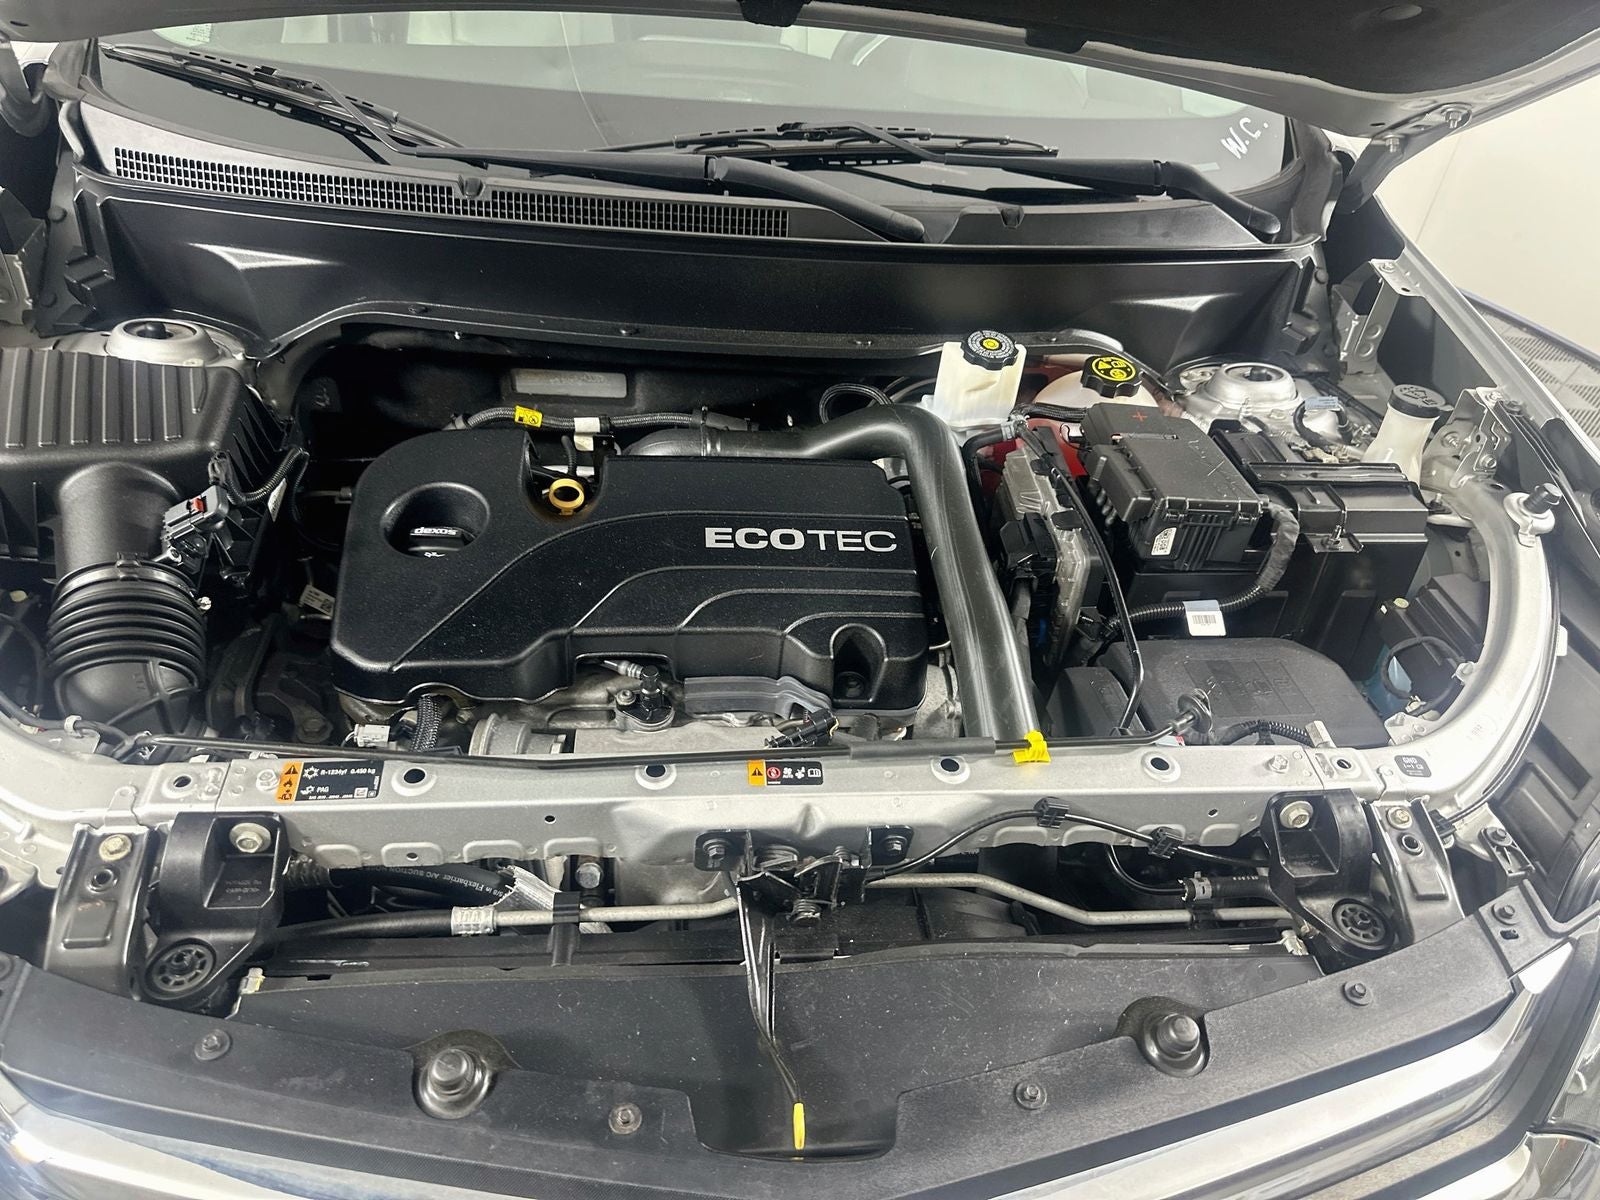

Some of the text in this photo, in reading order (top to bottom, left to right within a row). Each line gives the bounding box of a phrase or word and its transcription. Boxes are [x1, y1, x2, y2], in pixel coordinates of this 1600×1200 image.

[1221, 117, 1269, 159] W.C.
[414, 526, 458, 535] dexos
[704, 527, 898, 552] ECOTEC
[389, 866, 424, 878] SUCTION
[425, 871, 440, 879] A/C
[442, 873, 484, 893] Flexbarrier
